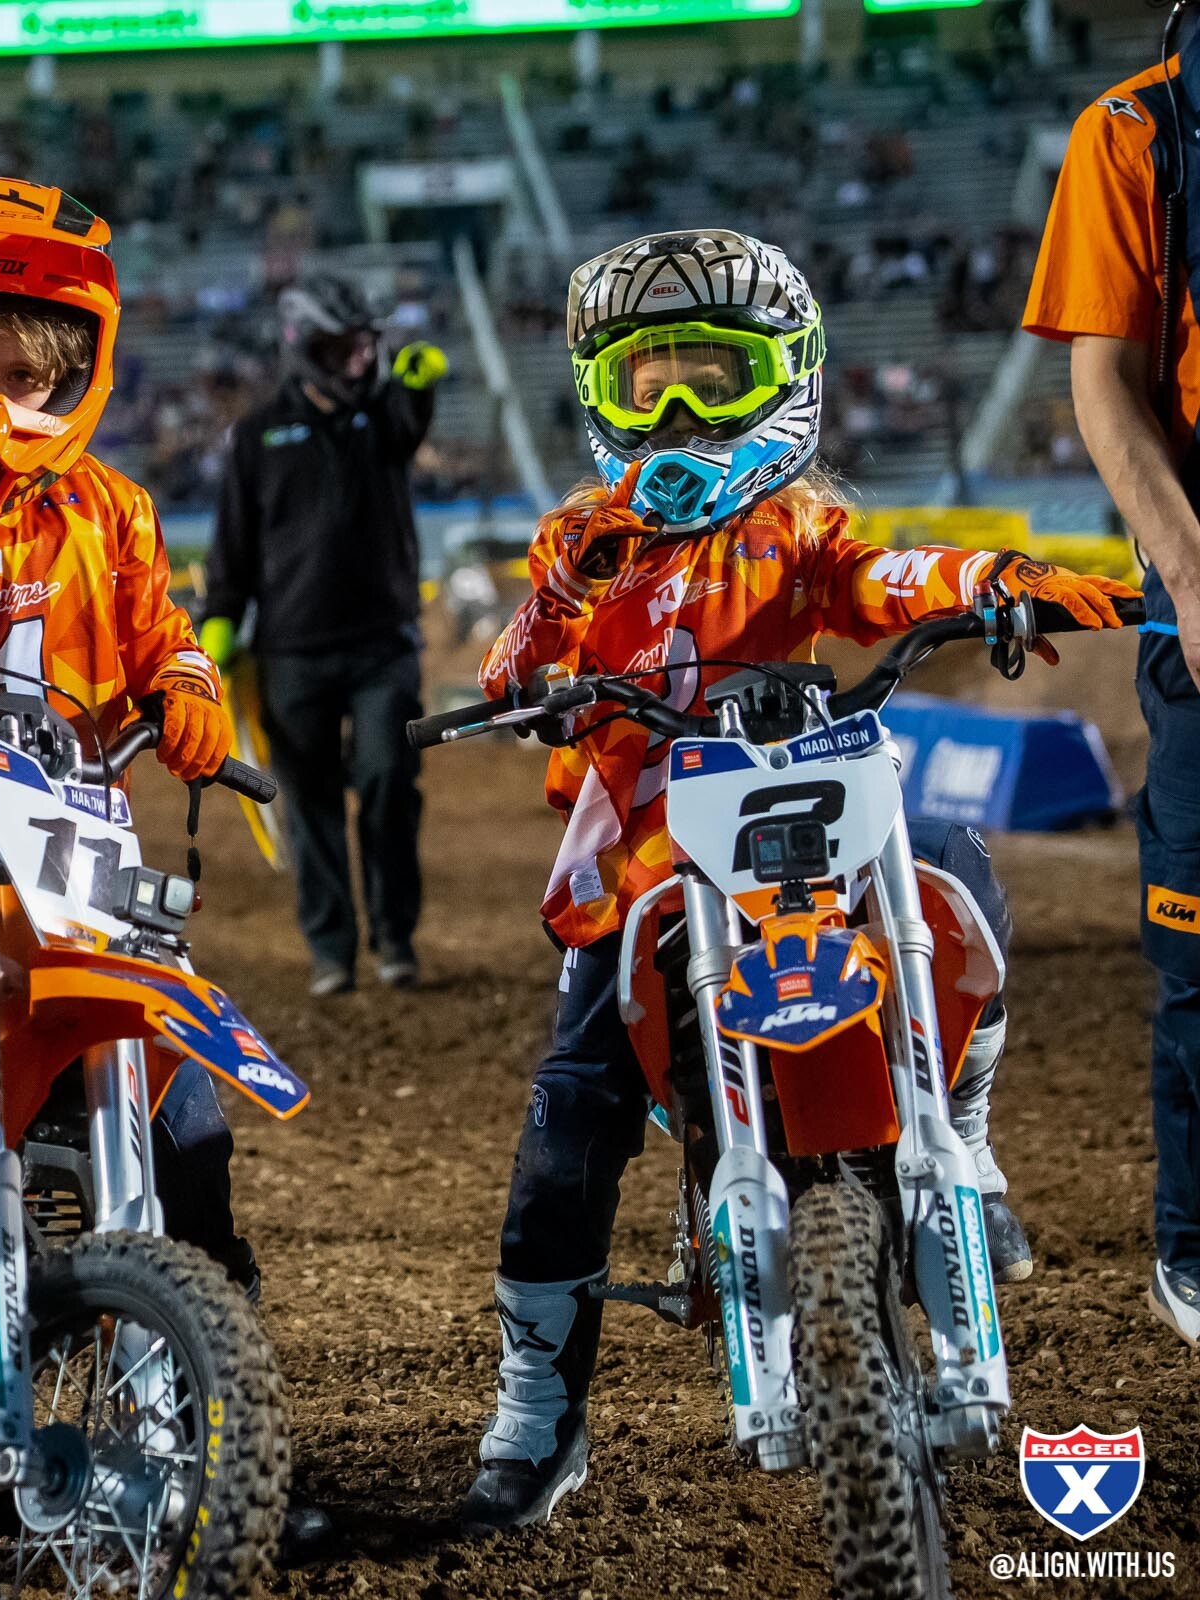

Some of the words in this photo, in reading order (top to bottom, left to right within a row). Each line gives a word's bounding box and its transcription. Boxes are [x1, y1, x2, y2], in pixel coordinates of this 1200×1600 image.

[652, 285, 680, 295] BELL
[752, 511, 778, 521] ELLS
[647, 566, 689, 628] KT
[732, 779, 846, 874] 2
[28, 817, 122, 917] 11
[1156, 900, 1197, 923] KTM
[759, 1002, 838, 1033] KTM
[237, 1062, 296, 1096] KTM
[738, 1224, 765, 1363] DUNLOP
[934, 1191, 970, 1330] DUNLOP
[0, 1226, 24, 1374] DUNLOP
[718, 1263, 741, 1368] MOTOREX
